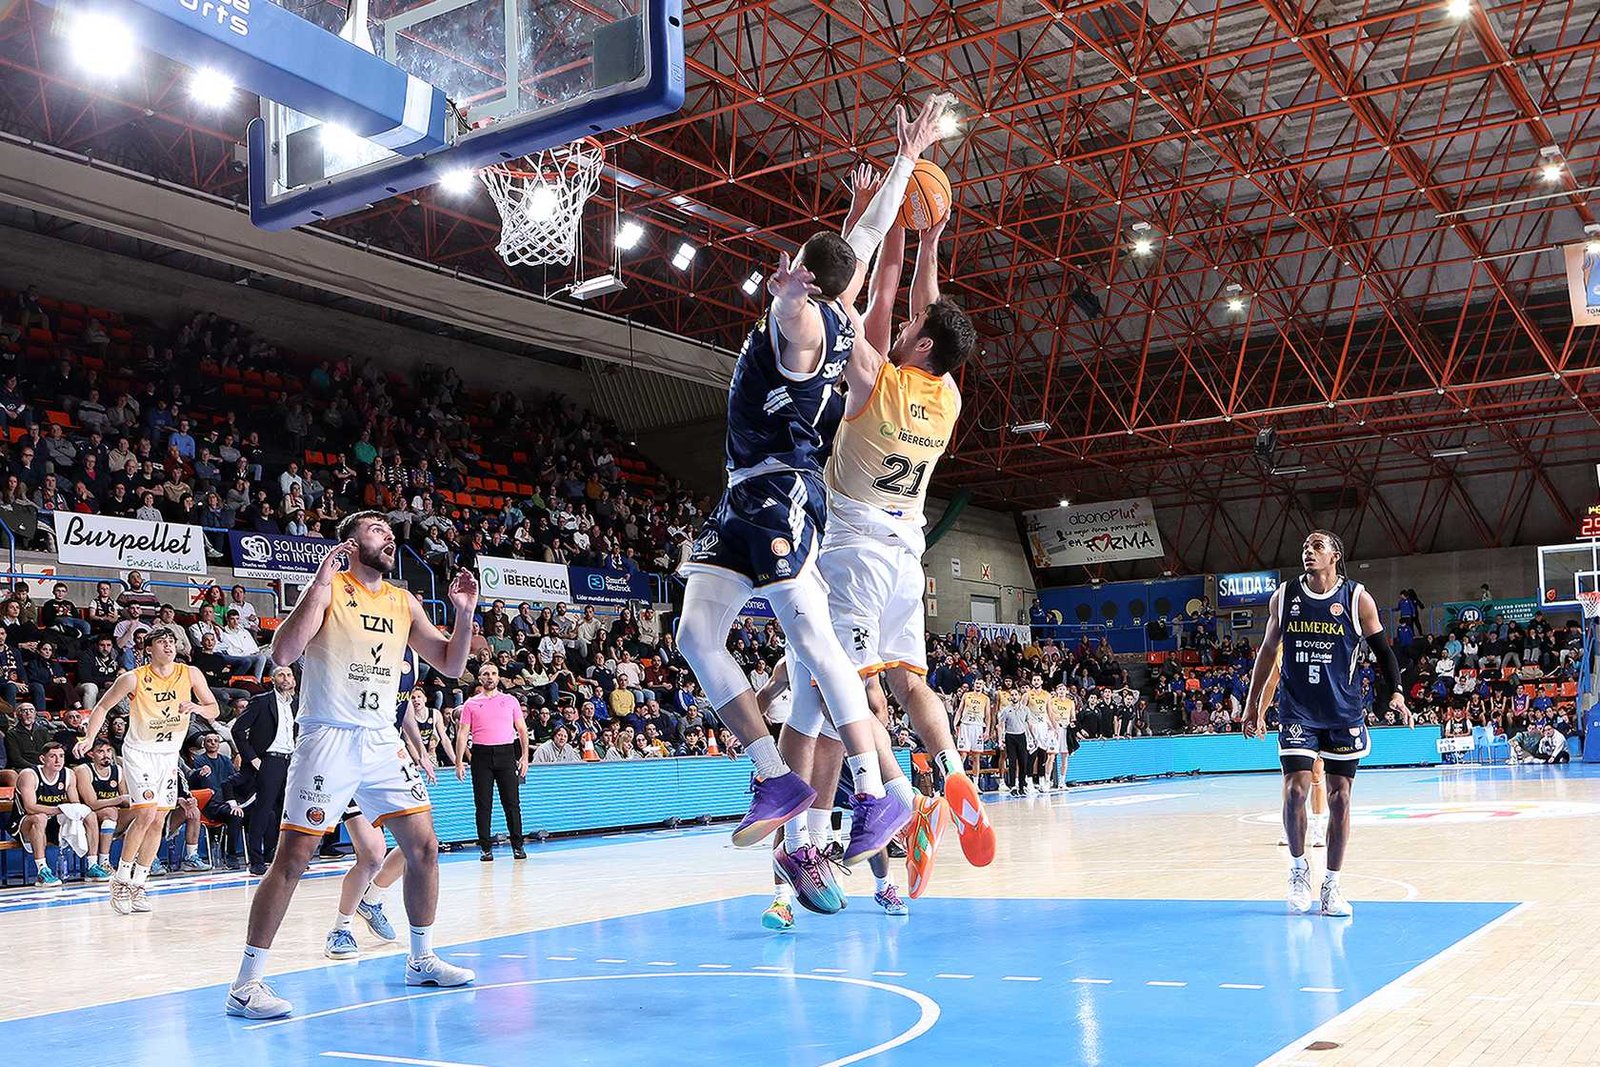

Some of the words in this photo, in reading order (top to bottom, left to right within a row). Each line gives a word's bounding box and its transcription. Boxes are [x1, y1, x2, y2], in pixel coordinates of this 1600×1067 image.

[910, 403, 929, 420] GIL
[898, 430, 945, 448] IBEREÓLICA
[872, 453, 929, 498] 21
[63, 515, 192, 560] Burpellet
[273, 539, 336, 554] SOLUCION
[165, 558, 201, 572] Natural
[275, 552, 290, 562] en
[503, 573, 568, 590] IBEREÓLICA
[605, 583, 631, 593] Westrock
[1219, 576, 1263, 597] SALIDA
[360, 614, 393, 634] TZN
[1286, 621, 1345, 636] ALIMERKA
[348, 673, 370, 683] Burgos
[1308, 664, 1320, 684] 5
[154, 691, 176, 702] TZN
[358, 689, 380, 710] 13
[156, 732, 172, 742] 24
